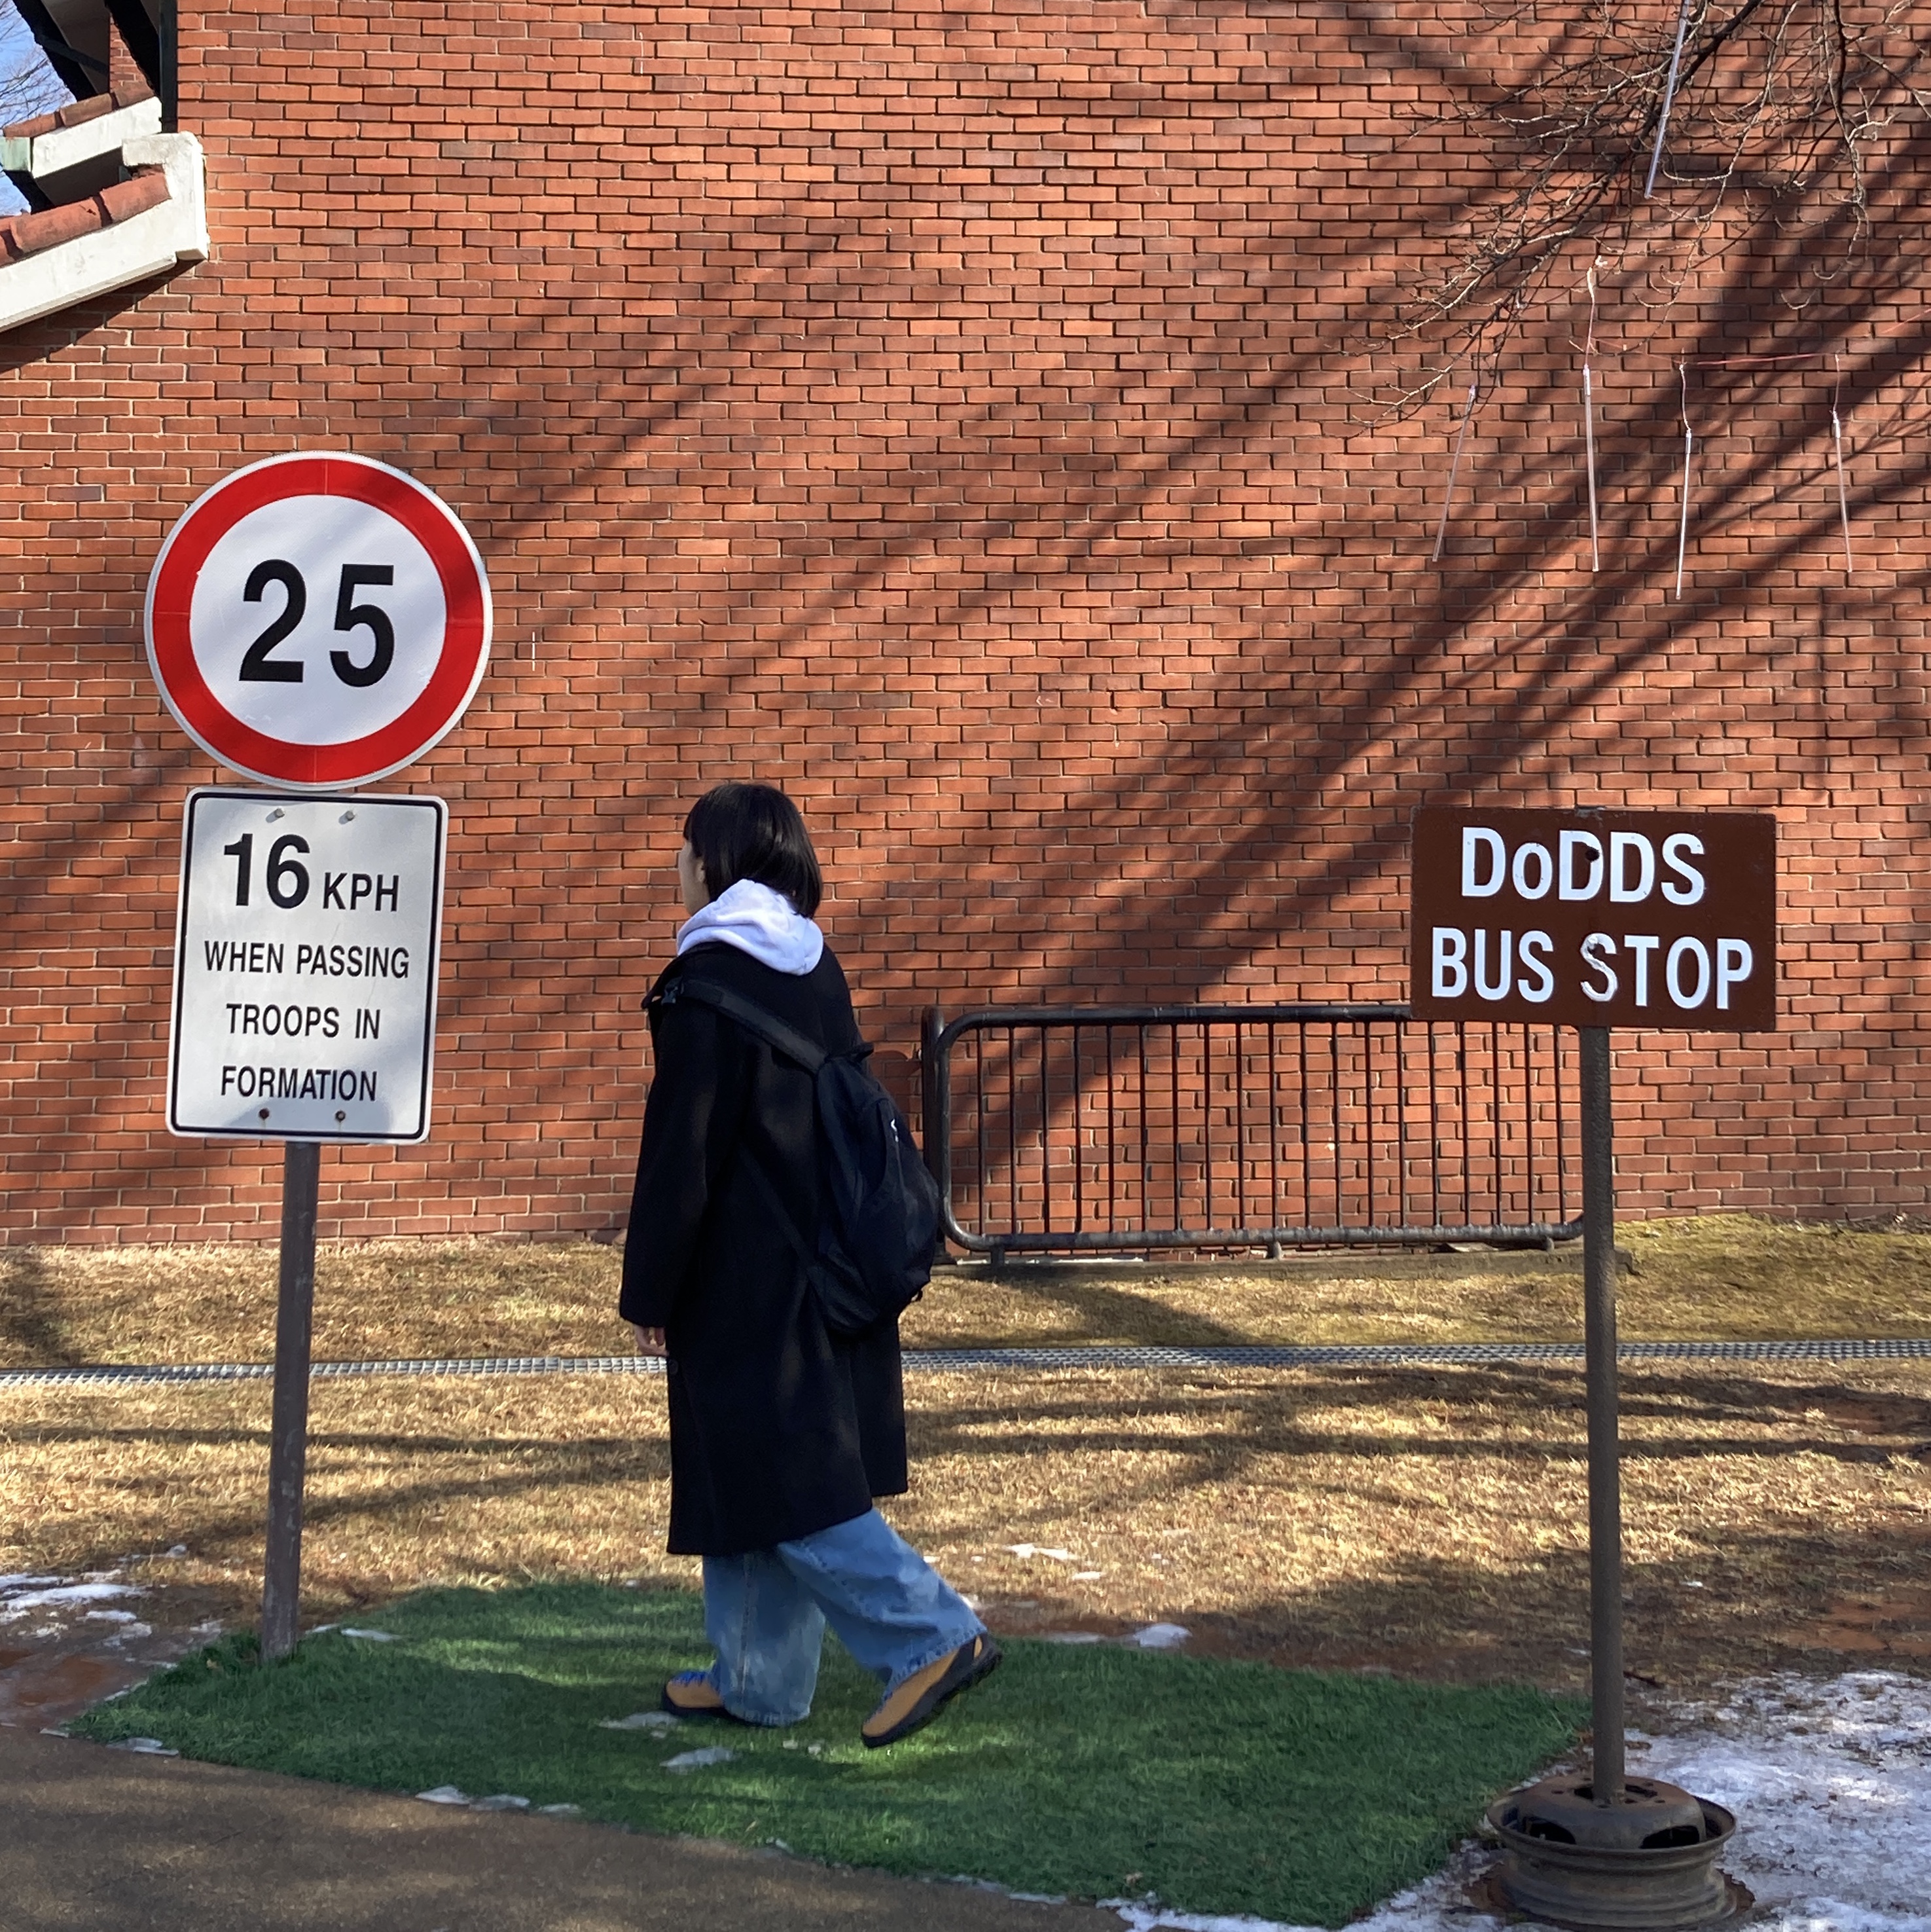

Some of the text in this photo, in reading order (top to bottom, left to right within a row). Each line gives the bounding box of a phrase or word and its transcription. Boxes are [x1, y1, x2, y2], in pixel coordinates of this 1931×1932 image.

[238, 558, 395, 688] 25
[223, 833, 399, 912] 16 KPH
[1462, 826, 1705, 905] DoDDS
[204, 940, 409, 979] WHEN PASSING
[1432, 926, 1753, 1010] BUS STOP
[226, 1003, 380, 1040] TROOPS IN
[221, 1065, 377, 1102] FORMATION
